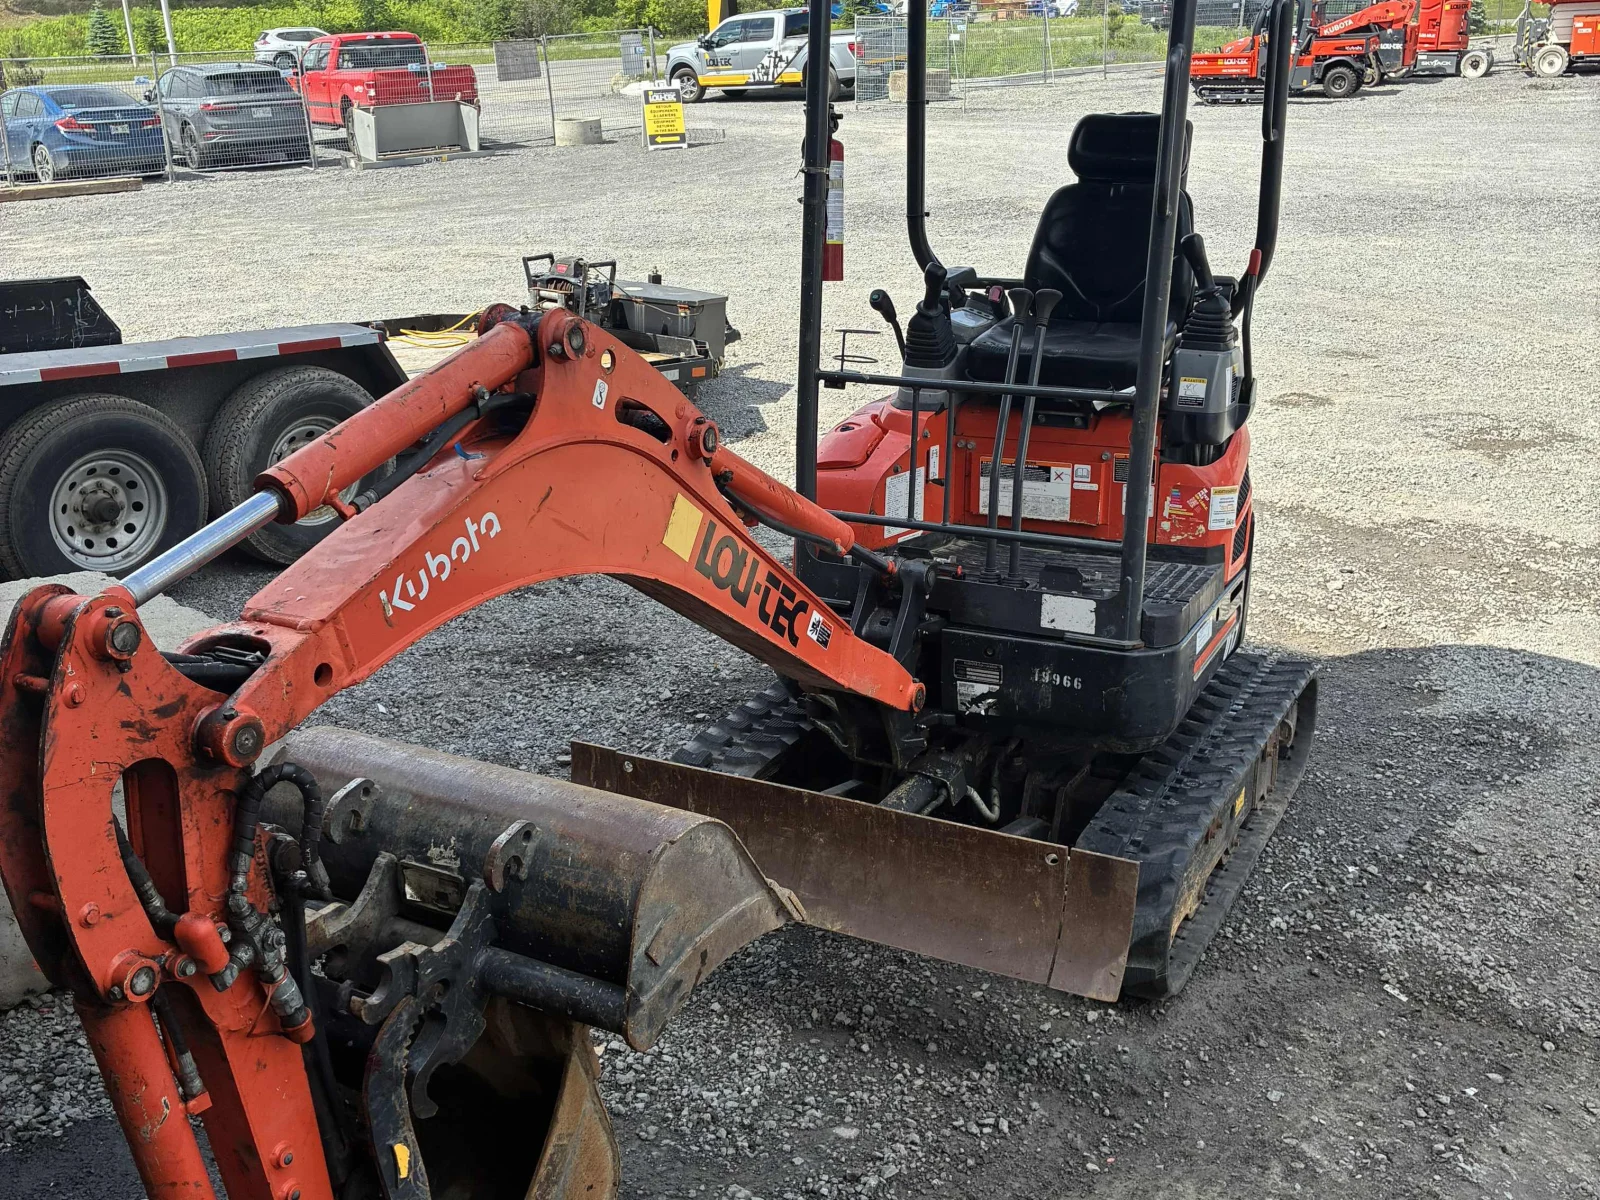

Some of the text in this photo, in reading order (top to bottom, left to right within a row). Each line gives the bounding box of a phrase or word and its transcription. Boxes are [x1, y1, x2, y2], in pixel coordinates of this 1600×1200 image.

[1323, 18, 1354, 36] KUBOTA
[704, 55, 732, 67] LOU-TEC
[379, 511, 502, 618] Kubota
[694, 519, 810, 648] LOU-TEC
